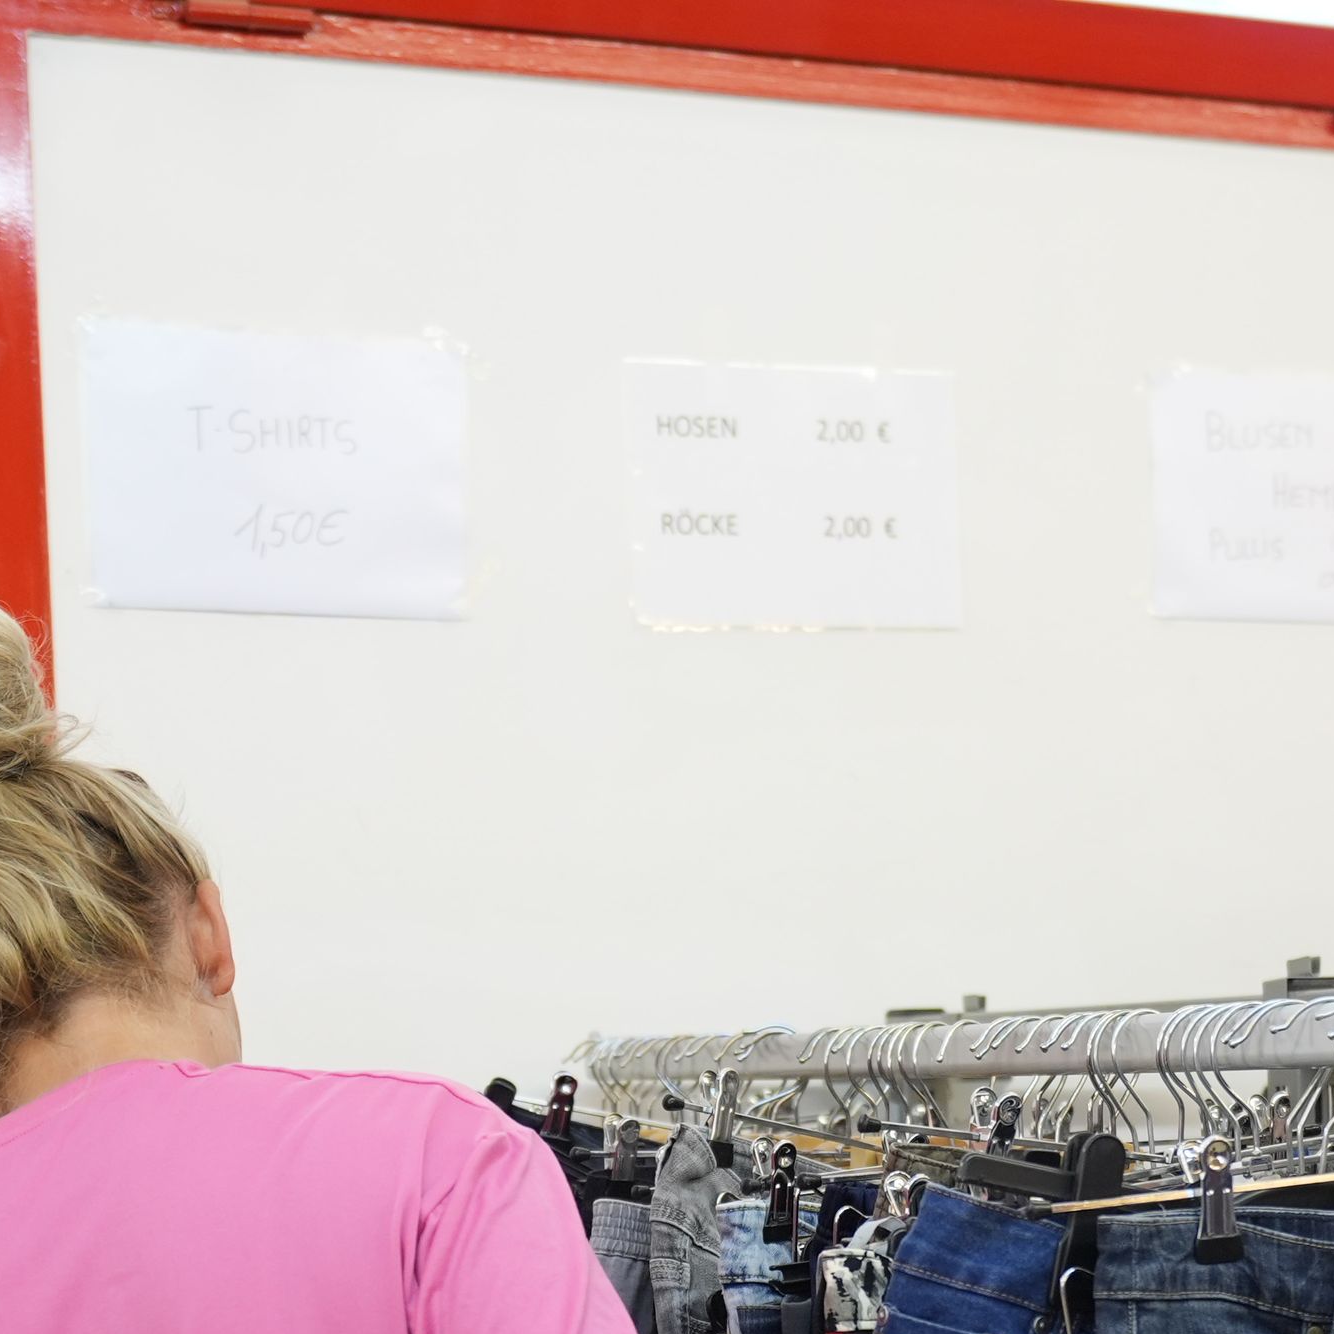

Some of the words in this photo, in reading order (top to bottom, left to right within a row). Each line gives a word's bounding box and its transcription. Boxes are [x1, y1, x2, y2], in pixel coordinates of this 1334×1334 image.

[656, 415, 738, 439] HOSEN
[816, 419, 865, 444] 2,00
[876, 421, 892, 443] €
[233, 504, 351, 560] 1,50€
[661, 508, 739, 536] RÖCKE
[823, 516, 872, 541] 2,00
[884, 518, 898, 539] €
